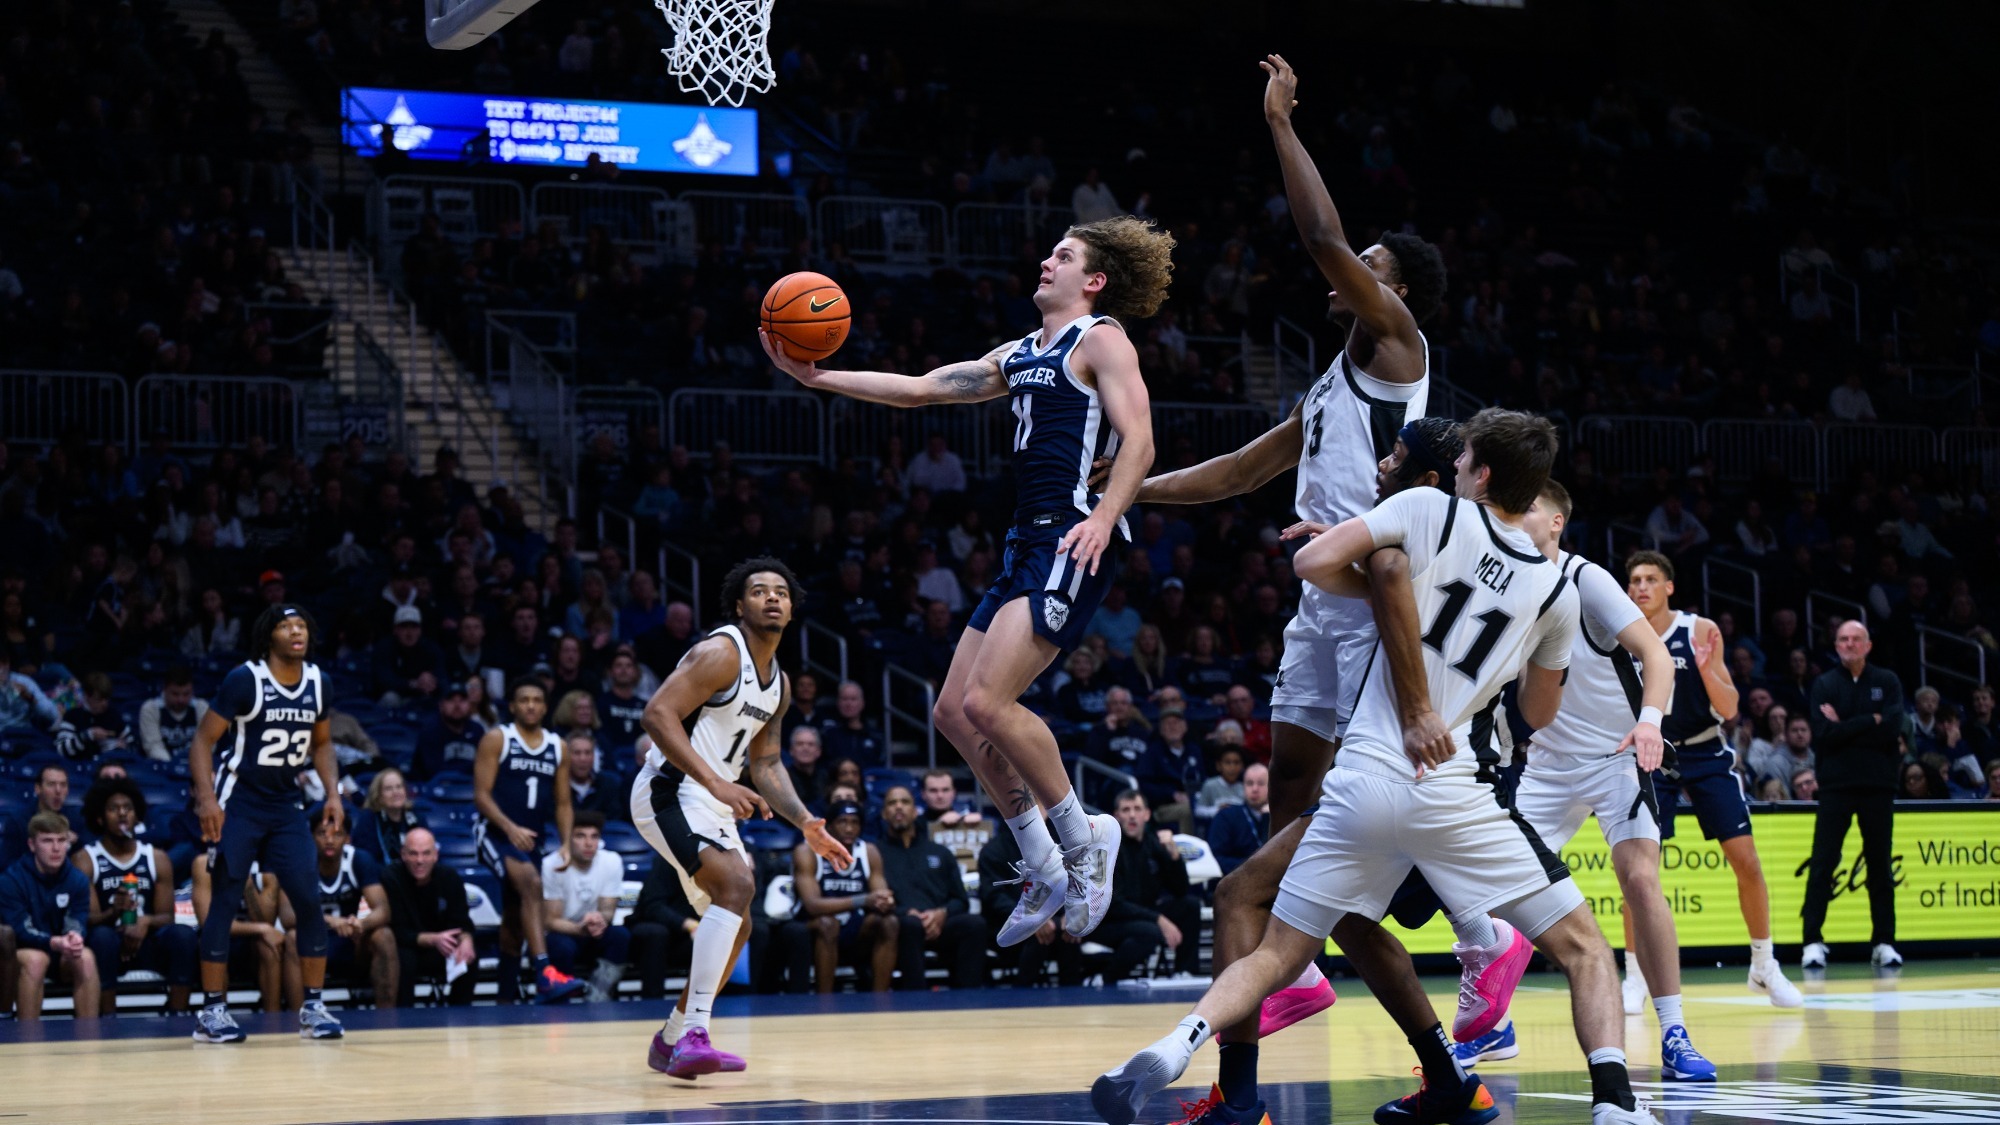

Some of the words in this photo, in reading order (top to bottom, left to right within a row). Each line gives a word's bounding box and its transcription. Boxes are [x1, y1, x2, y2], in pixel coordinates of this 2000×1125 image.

[486, 119, 509, 138] TO
[557, 124, 579, 141] TO
[1475, 552, 1514, 596] MELA
[1420, 577, 1516, 687] 11
[265, 708, 317, 724] BUTLER
[257, 728, 312, 767] 23
[510, 758, 556, 776] BUTLER
[525, 776, 539, 809] 1
[1920, 882, 1946, 908] of
